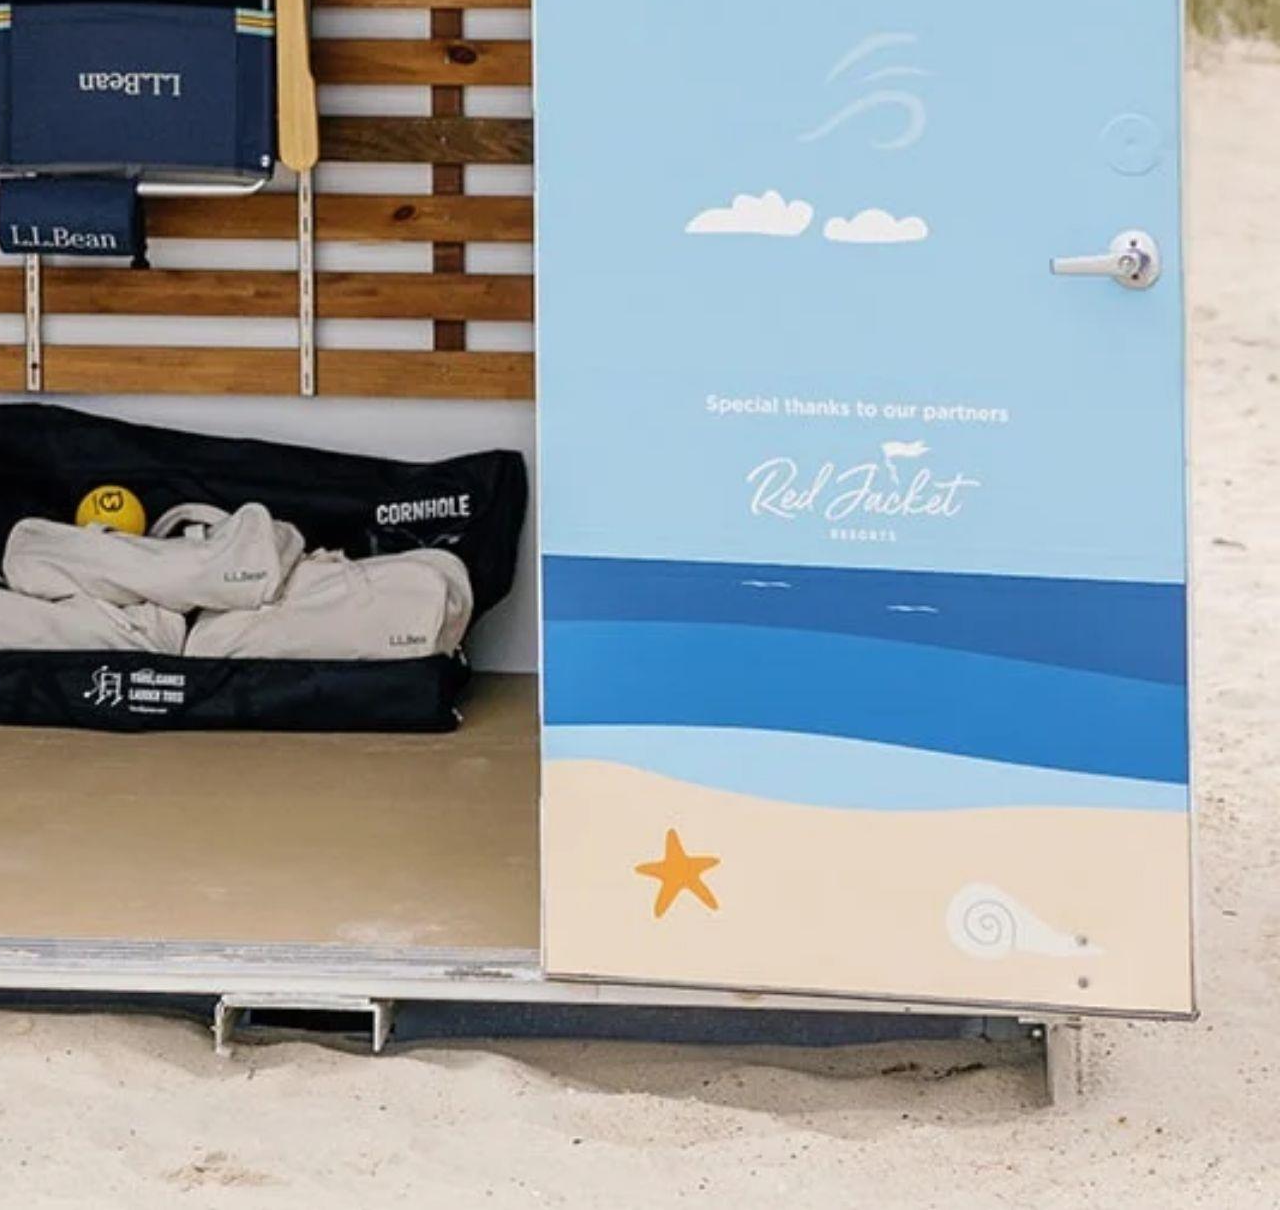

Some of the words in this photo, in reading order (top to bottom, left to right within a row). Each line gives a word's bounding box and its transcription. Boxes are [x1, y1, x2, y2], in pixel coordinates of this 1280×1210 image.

[79, 73, 180, 96] L.L.Bean
[11, 225, 116, 248] L.L.Bean
[707, 395, 778, 415] Special
[785, 398, 850, 416] thanks
[857, 401, 877, 418] to
[883, 405, 917, 418] our
[923, 406, 1008, 422] partners
[747, 457, 834, 519] Red
[824, 462, 980, 520] Jacket
[377, 495, 470, 524] CORNHOLE
